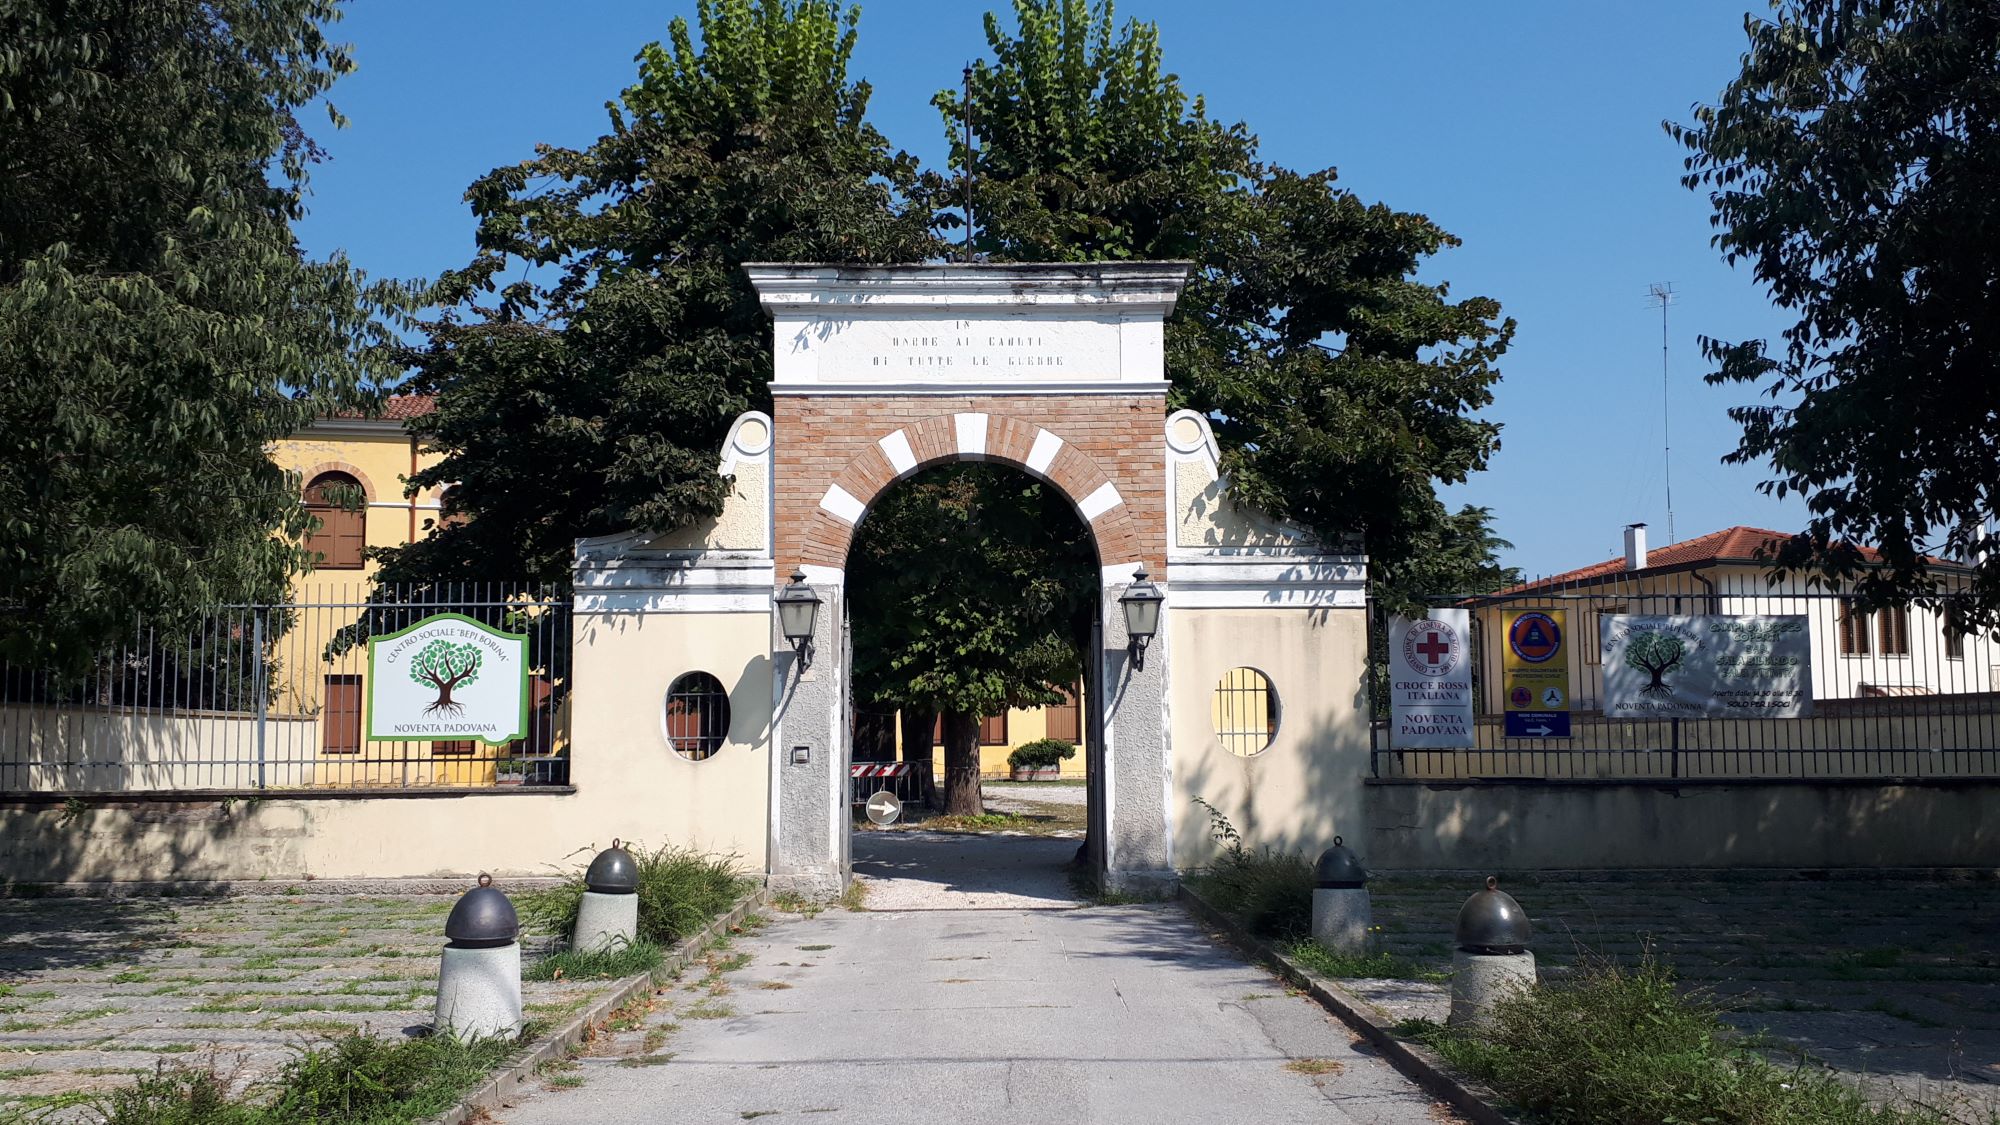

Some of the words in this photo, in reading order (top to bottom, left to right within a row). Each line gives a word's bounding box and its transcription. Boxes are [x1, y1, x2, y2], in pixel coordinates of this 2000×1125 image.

[972, 356, 989, 366] LE
[1419, 621, 1446, 632] GINEVRA
[1747, 622, 1762, 633] DA
[1605, 627, 1631, 652] CENTRO
[1630, 623, 1662, 633] SOCIALE
[386, 635, 418, 664] CENTRO
[418, 628, 456, 641] SOCIALE
[1395, 681, 1435, 690] CROCE
[1437, 681, 1469, 690] ROSSA
[1407, 691, 1461, 701] ITALIANA
[1615, 702, 1656, 711] NOVENTA
[1657, 702, 1703, 711] PADOVANA
[1405, 714, 1464, 724] NOVENTA
[394, 723, 441, 733] NOVENTA
[444, 723, 497, 733] PADOVANA
[1401, 725, 1467, 735] PADOVANA
